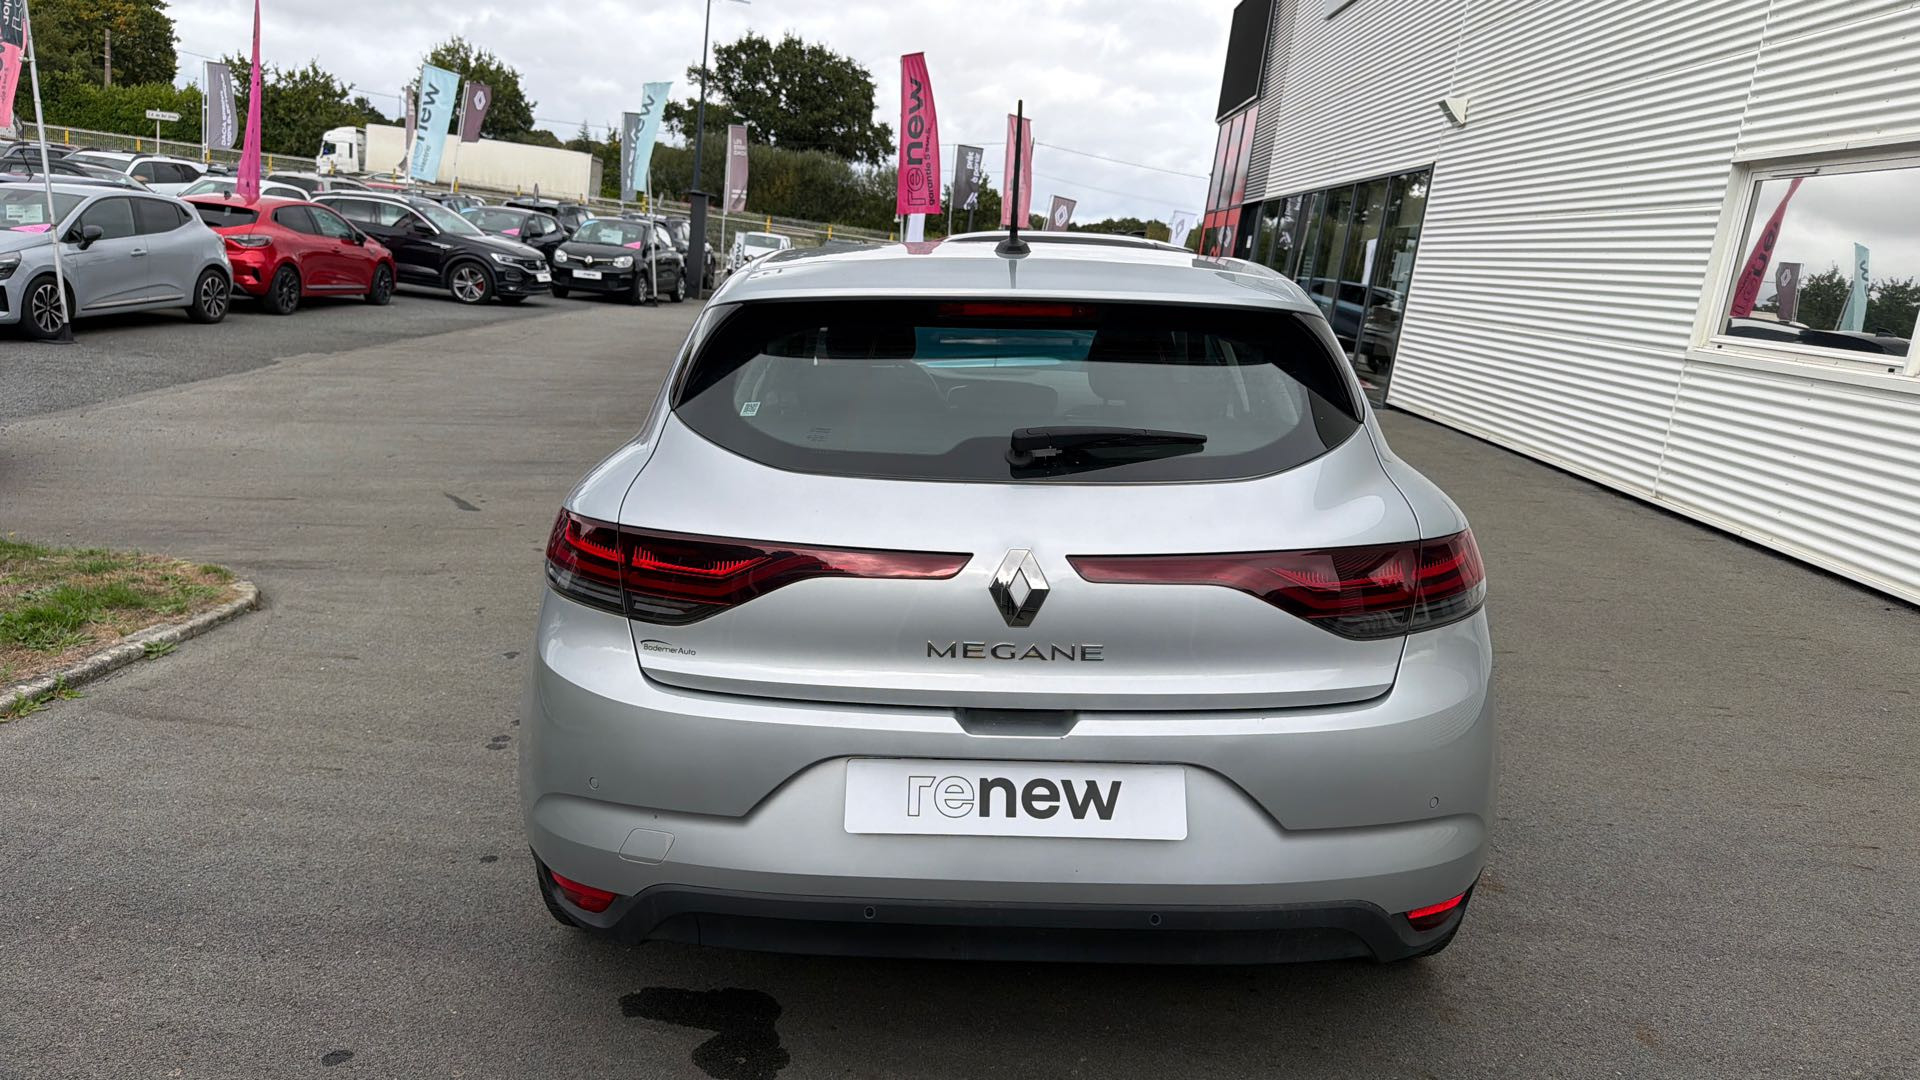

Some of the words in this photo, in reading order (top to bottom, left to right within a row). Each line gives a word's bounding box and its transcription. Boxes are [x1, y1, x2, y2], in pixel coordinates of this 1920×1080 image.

[907, 77, 926, 206] renew
[927, 640, 1104, 661] MEGANE
[907, 775, 1122, 821] renew
